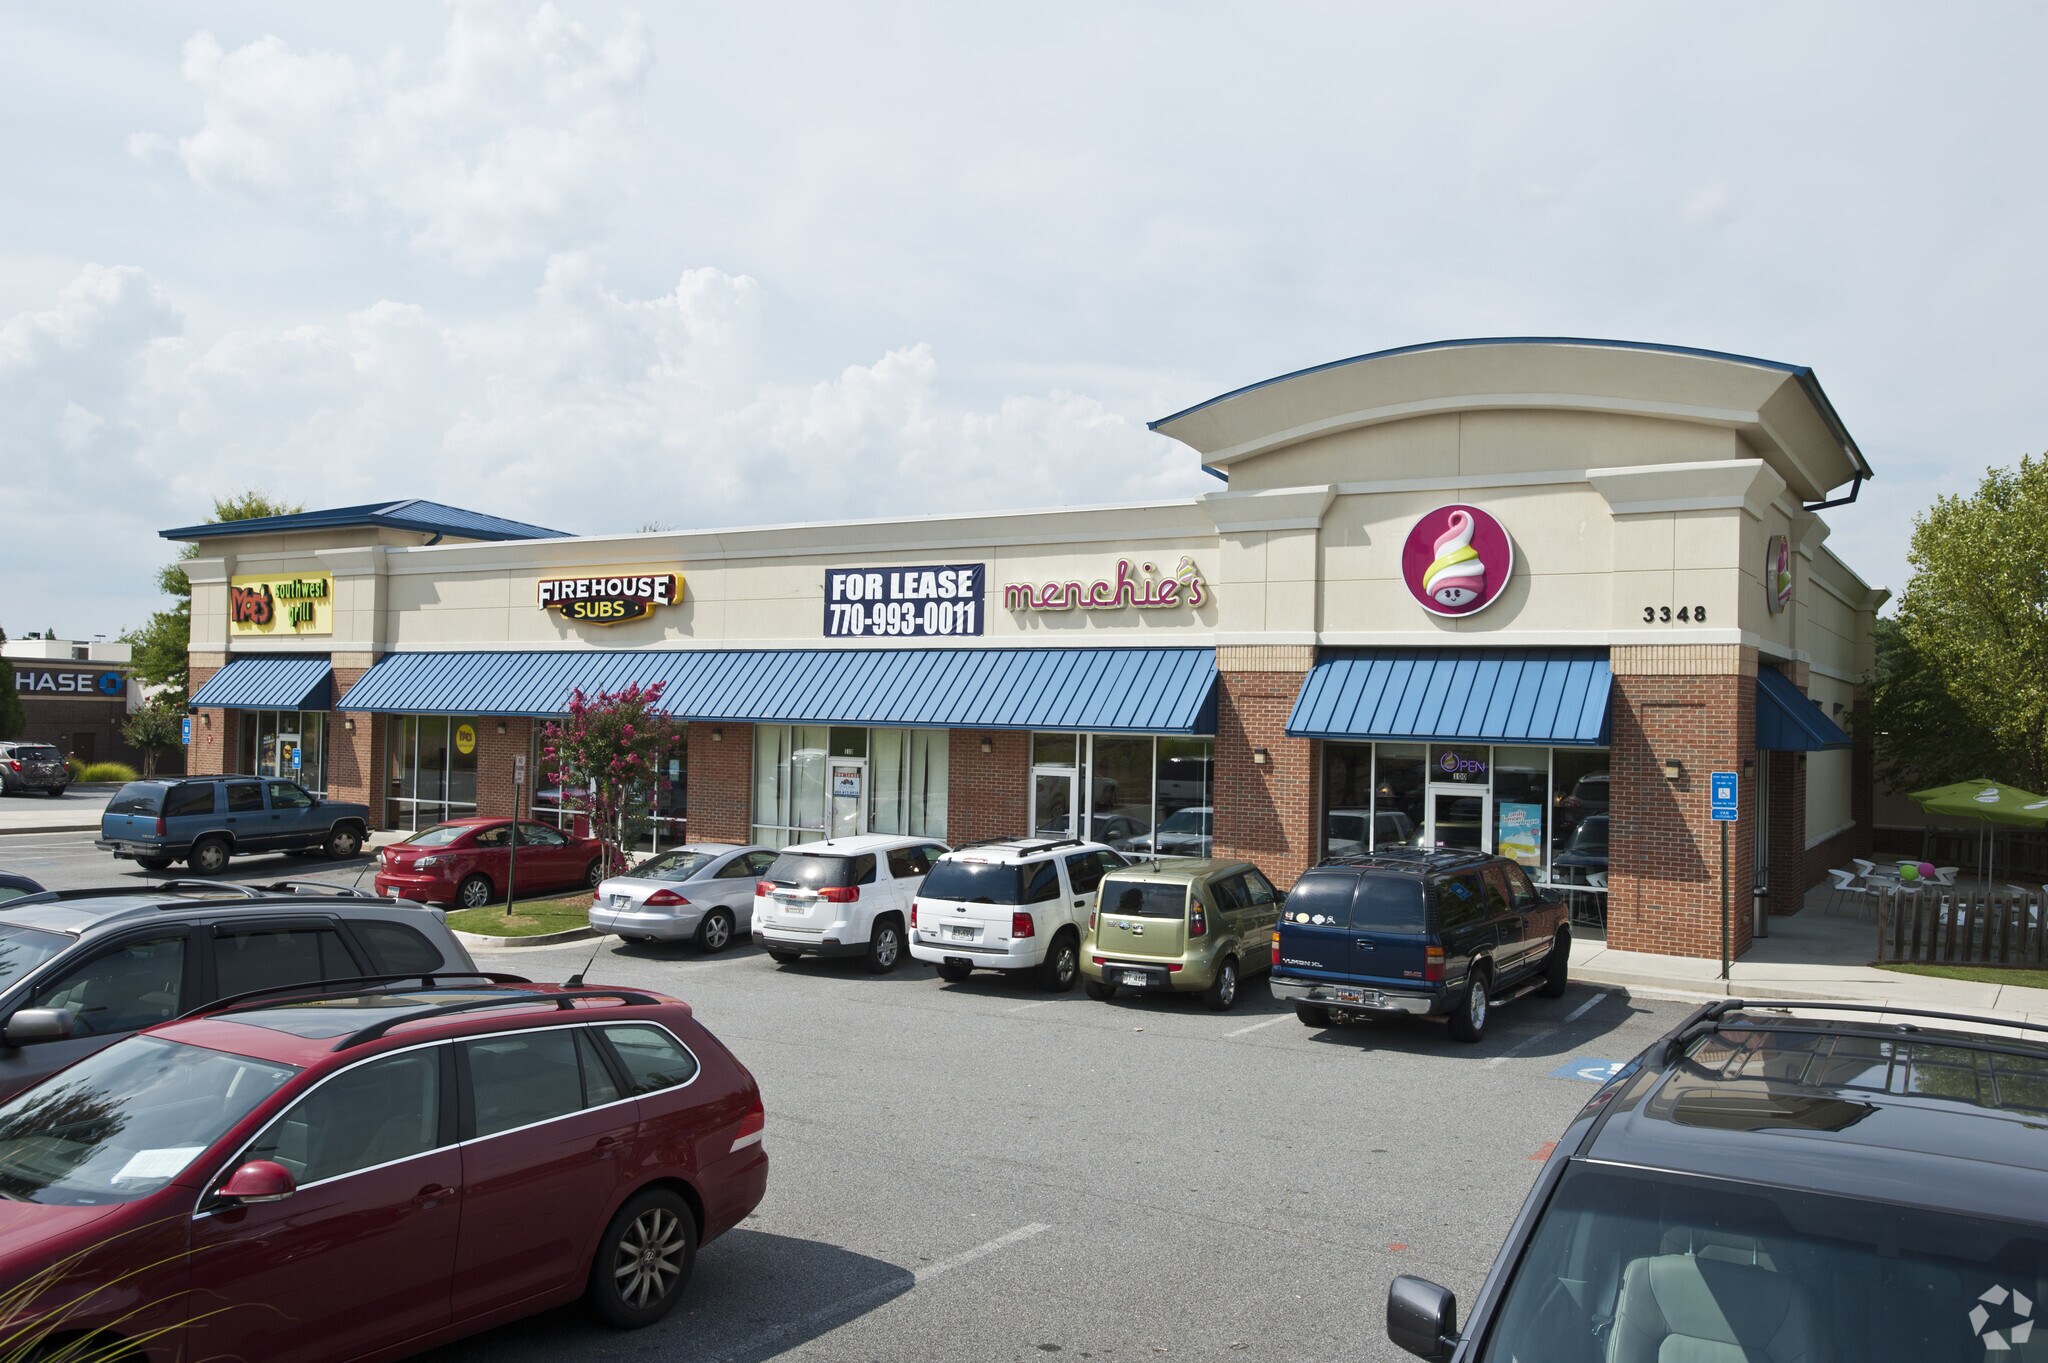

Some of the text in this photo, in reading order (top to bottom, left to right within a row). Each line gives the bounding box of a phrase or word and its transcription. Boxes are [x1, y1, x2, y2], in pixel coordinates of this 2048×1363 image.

[275, 579, 326, 598] southwest
[538, 575, 669, 610] FIREHOUSE
[832, 570, 973, 600] FOR LEASE
[1003, 556, 1204, 609] menchie's
[288, 602, 313, 627] grill
[574, 600, 625, 618] SUBS
[830, 601, 976, 635] 770-993-0011
[1643, 606, 1706, 622] 3348
[15, 672, 94, 692] HASE
[1440, 752, 1486, 772] OPEN
[1282, 958, 1311, 967] YUKON
